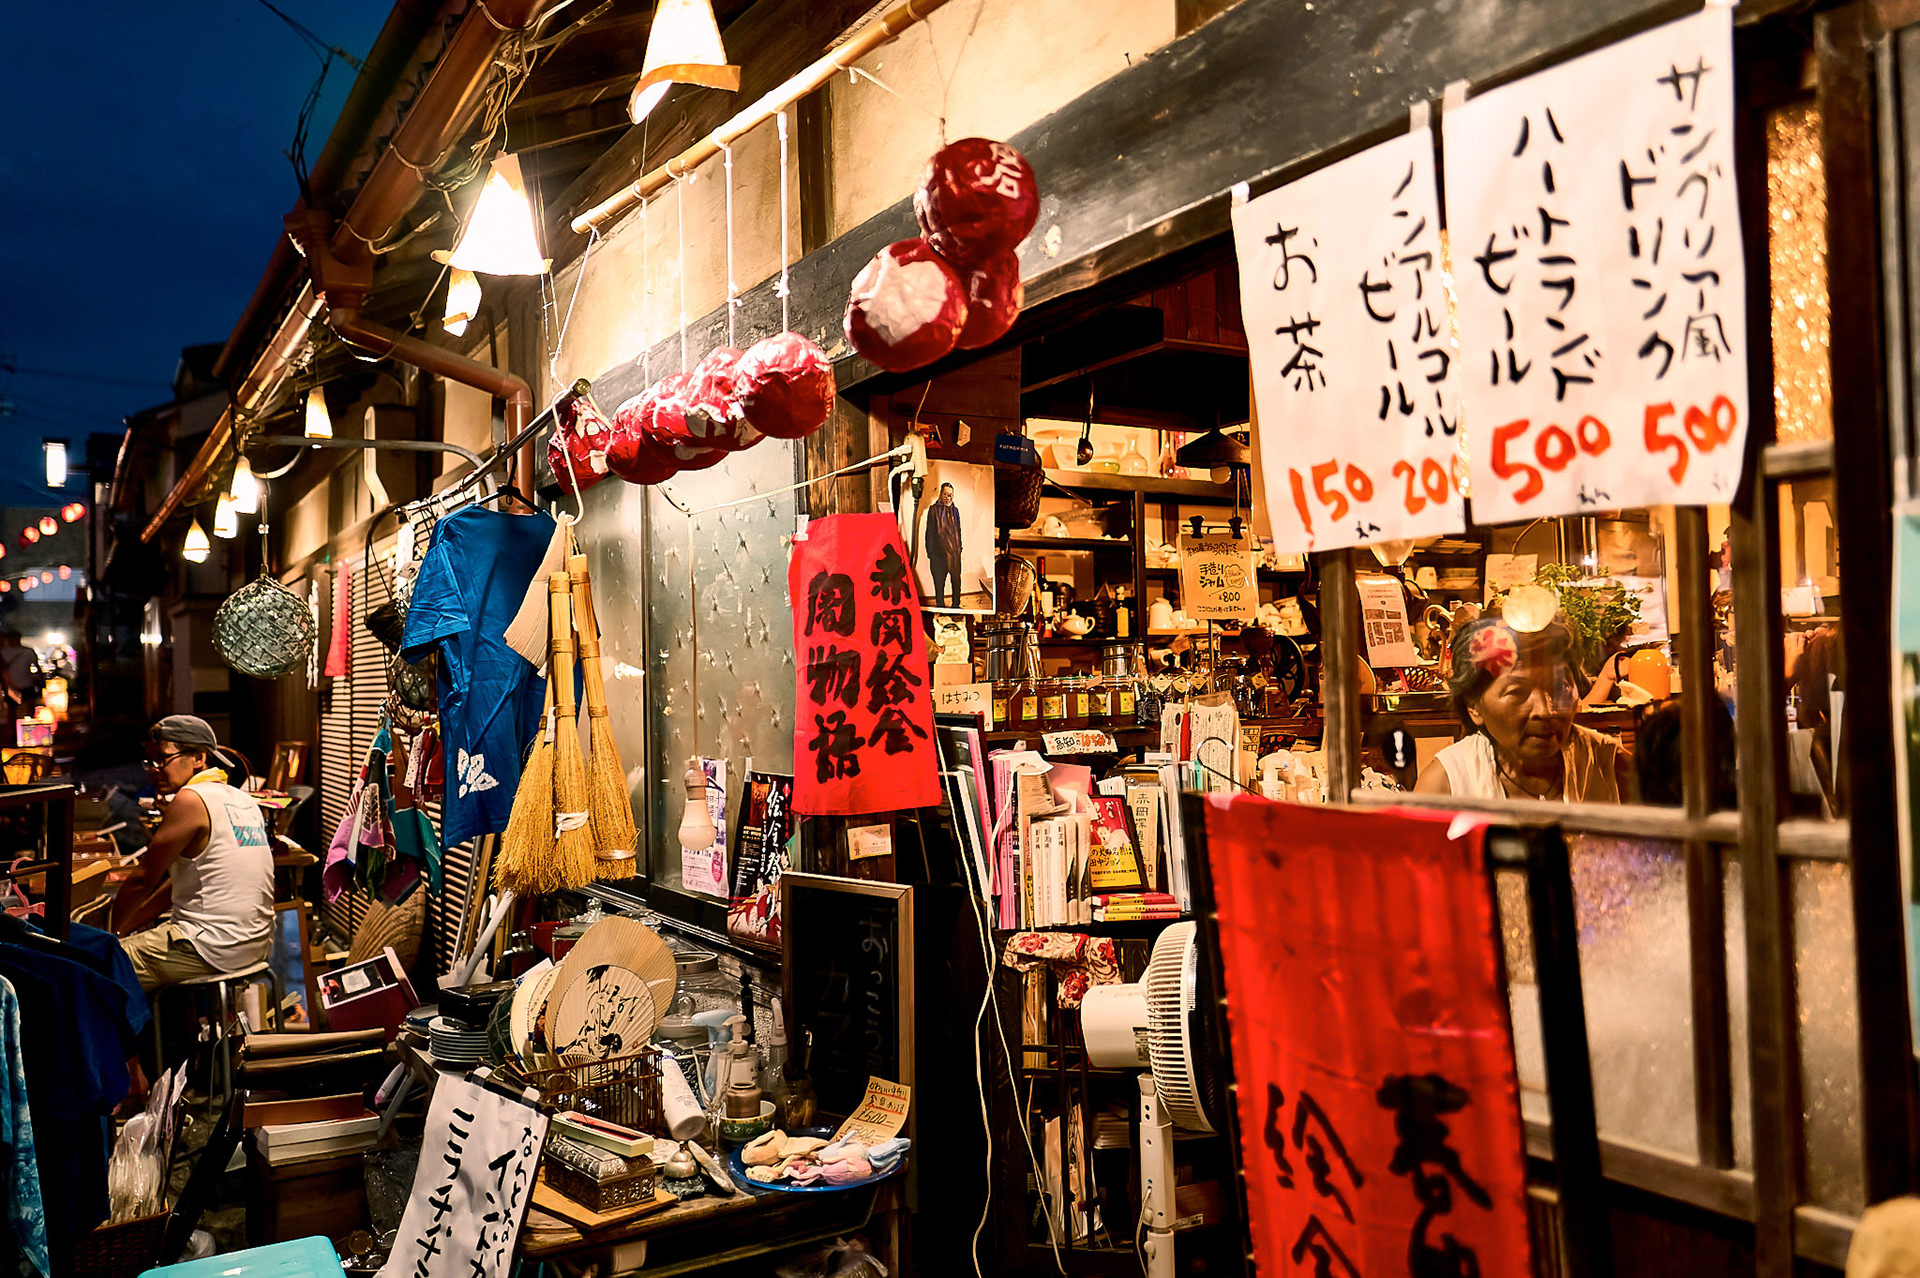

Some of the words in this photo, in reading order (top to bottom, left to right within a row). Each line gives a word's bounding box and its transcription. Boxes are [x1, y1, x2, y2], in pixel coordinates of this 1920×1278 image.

[1265, 221, 1327, 393] お茶
[1358, 252, 1415, 421] ビール
[1390, 160, 1458, 437] ノンアルコール
[1474, 224, 1532, 387] ビール
[1512, 107, 1602, 401] ハートランド
[1619, 144, 1676, 380] ドリンク
[1288, 459, 1373, 548] 150
[1490, 414, 1611, 504] 500
[1643, 395, 1738, 486] 500
[866, 543, 928, 756] 赤岡絵金
[1198, 576, 1225, 588] ジャム
[941, 691, 981, 705] はちみつ
